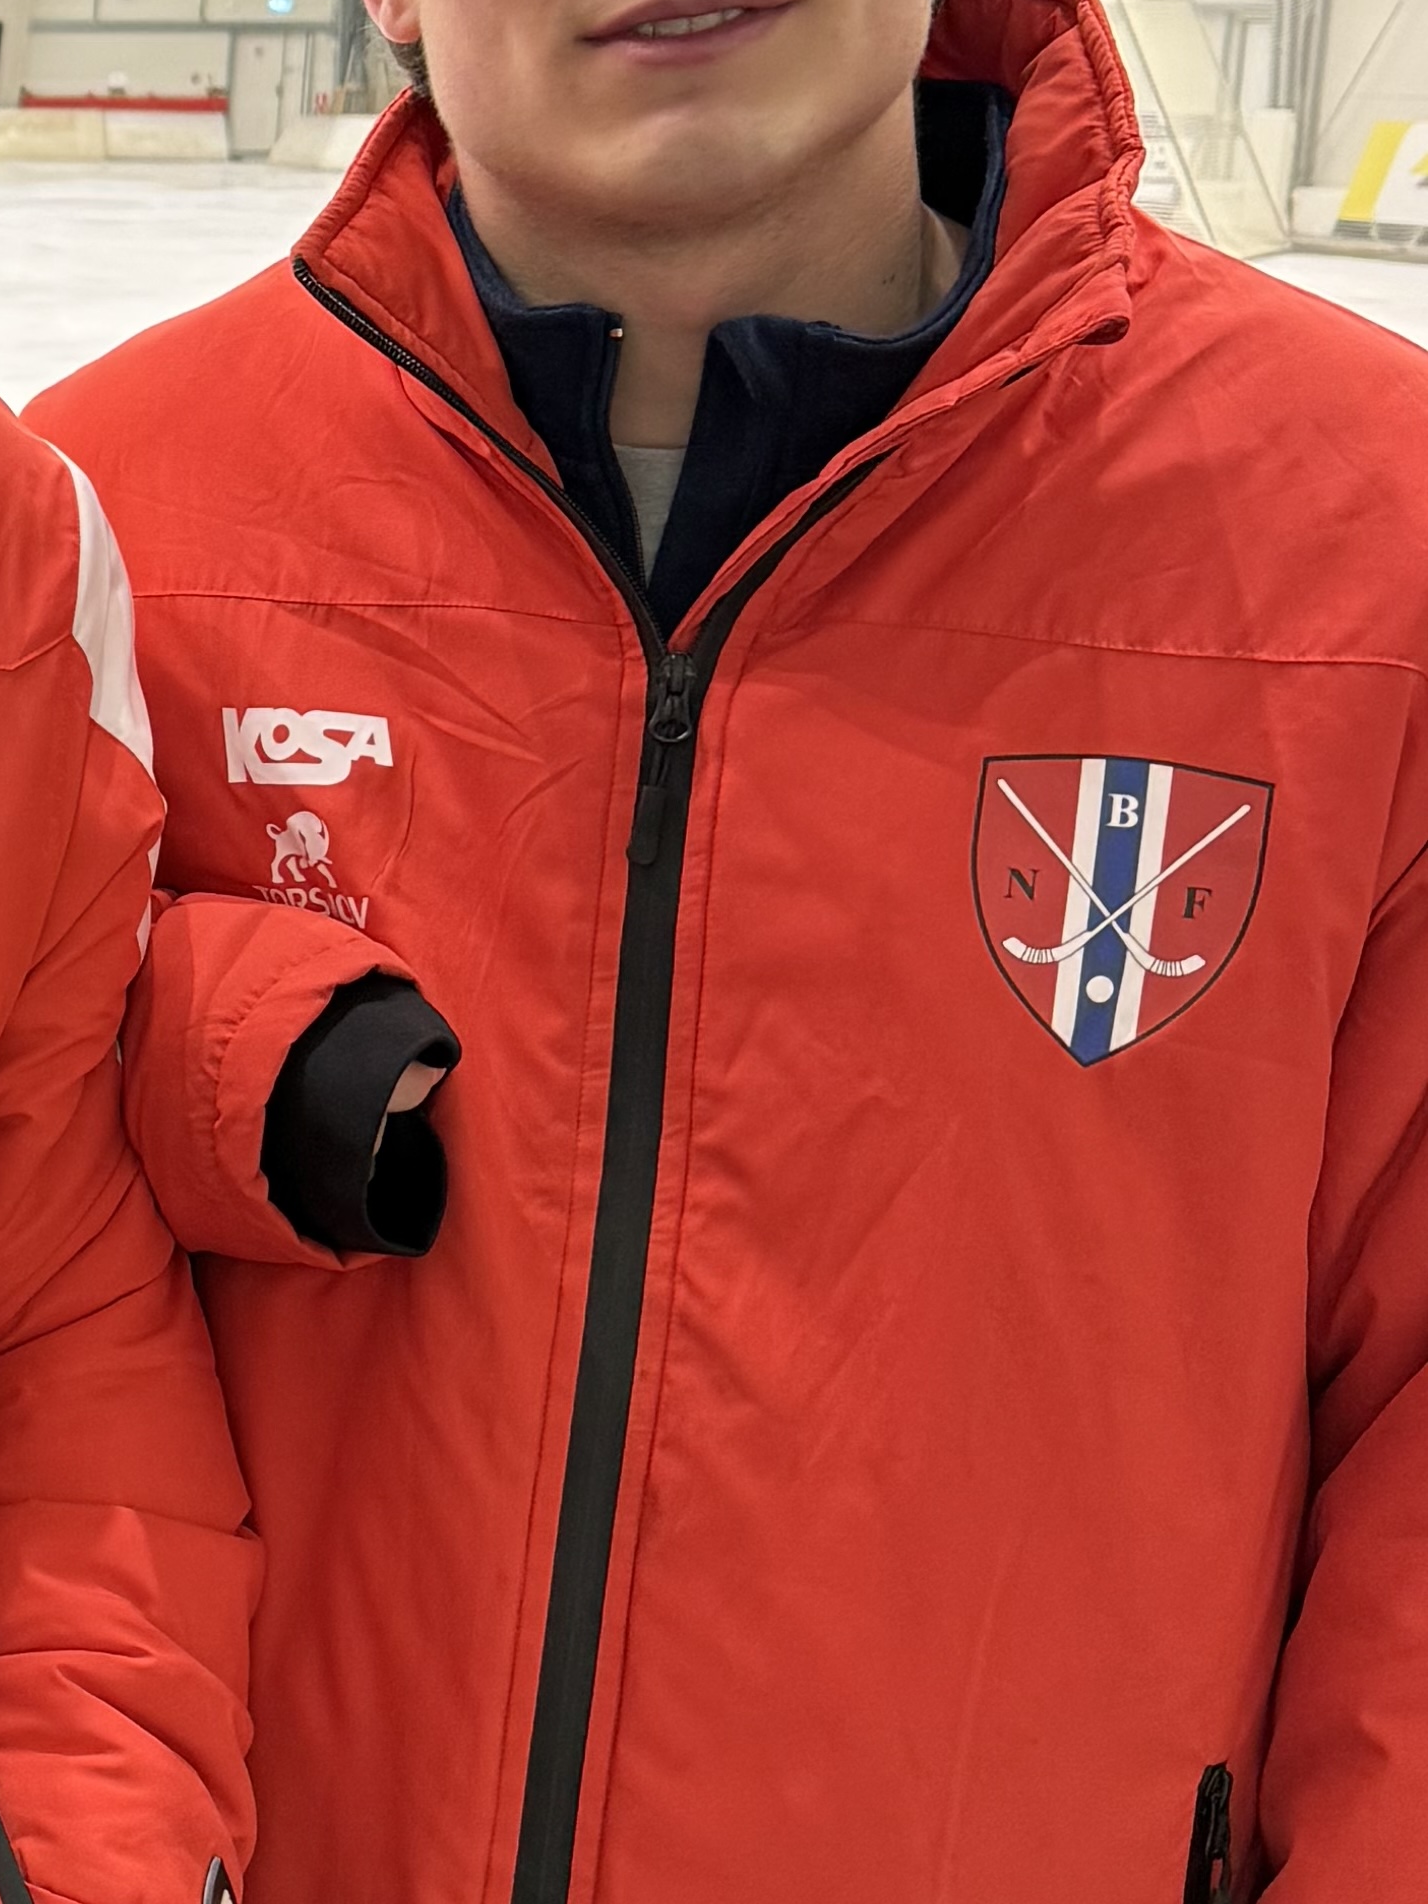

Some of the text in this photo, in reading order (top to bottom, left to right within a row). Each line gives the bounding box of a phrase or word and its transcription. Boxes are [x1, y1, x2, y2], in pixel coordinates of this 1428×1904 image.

[222, 707, 394, 786] KOSA
[1105, 793, 1139, 828] B
[1003, 867, 1213, 920] N F
